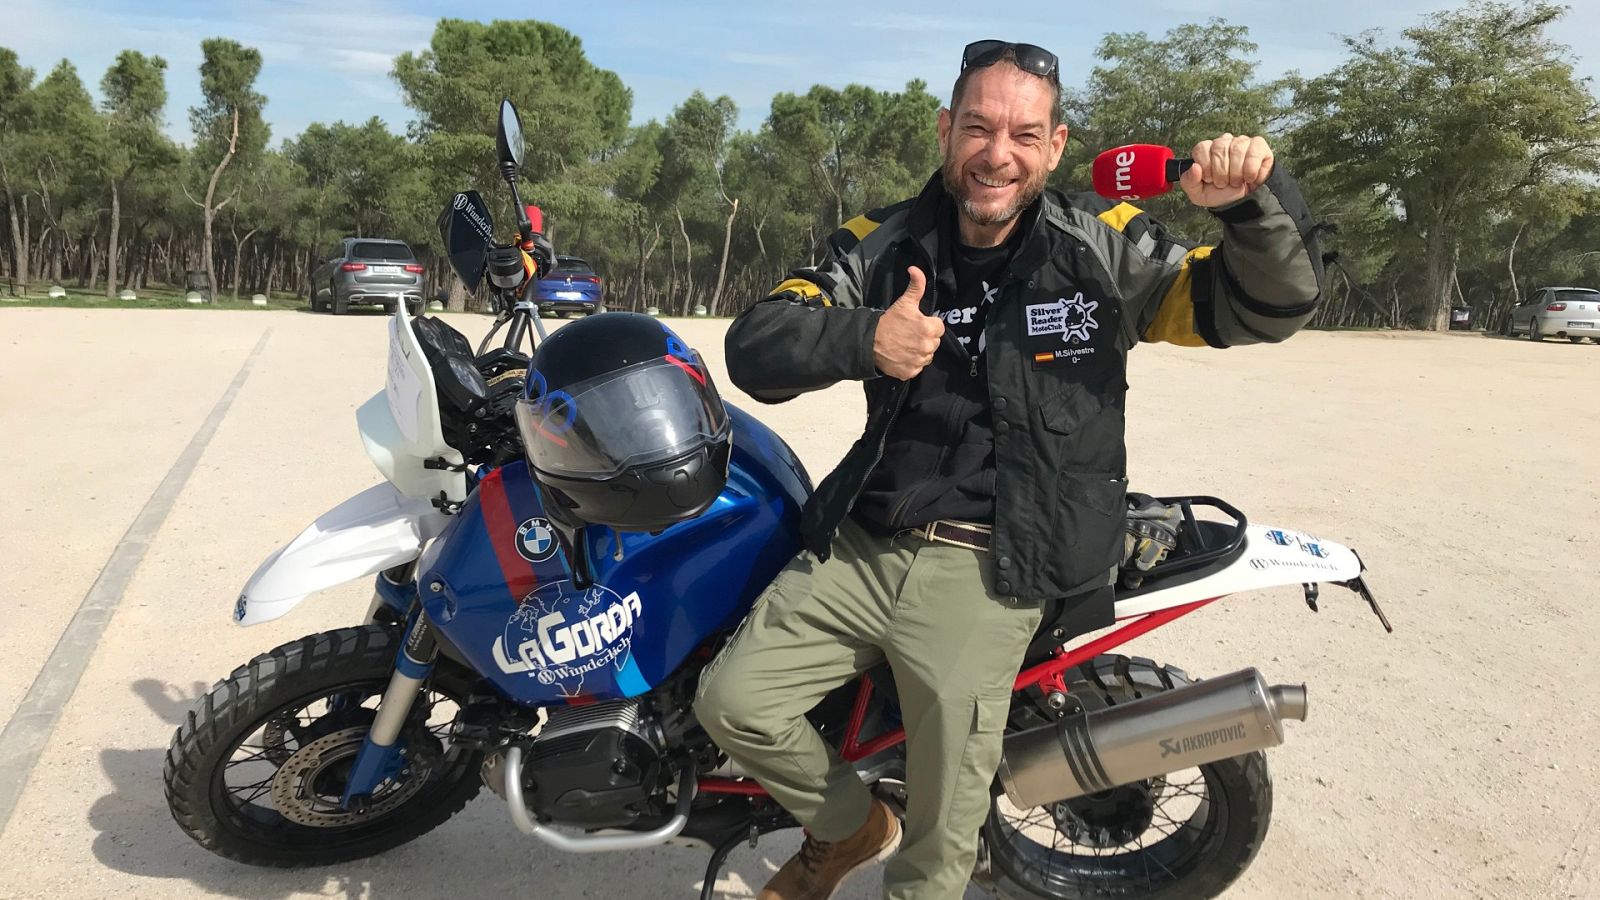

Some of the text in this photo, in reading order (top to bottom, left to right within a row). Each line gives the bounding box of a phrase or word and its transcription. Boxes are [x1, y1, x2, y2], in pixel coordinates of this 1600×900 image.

[1115, 151, 1136, 191] rne
[1030, 307, 1062, 316] Silver
[1031, 316, 1063, 326] Reader
[1031, 324, 1063, 334] MotoClub
[519, 519, 553, 535] BMW
[555, 636, 632, 679] Wunderlich
